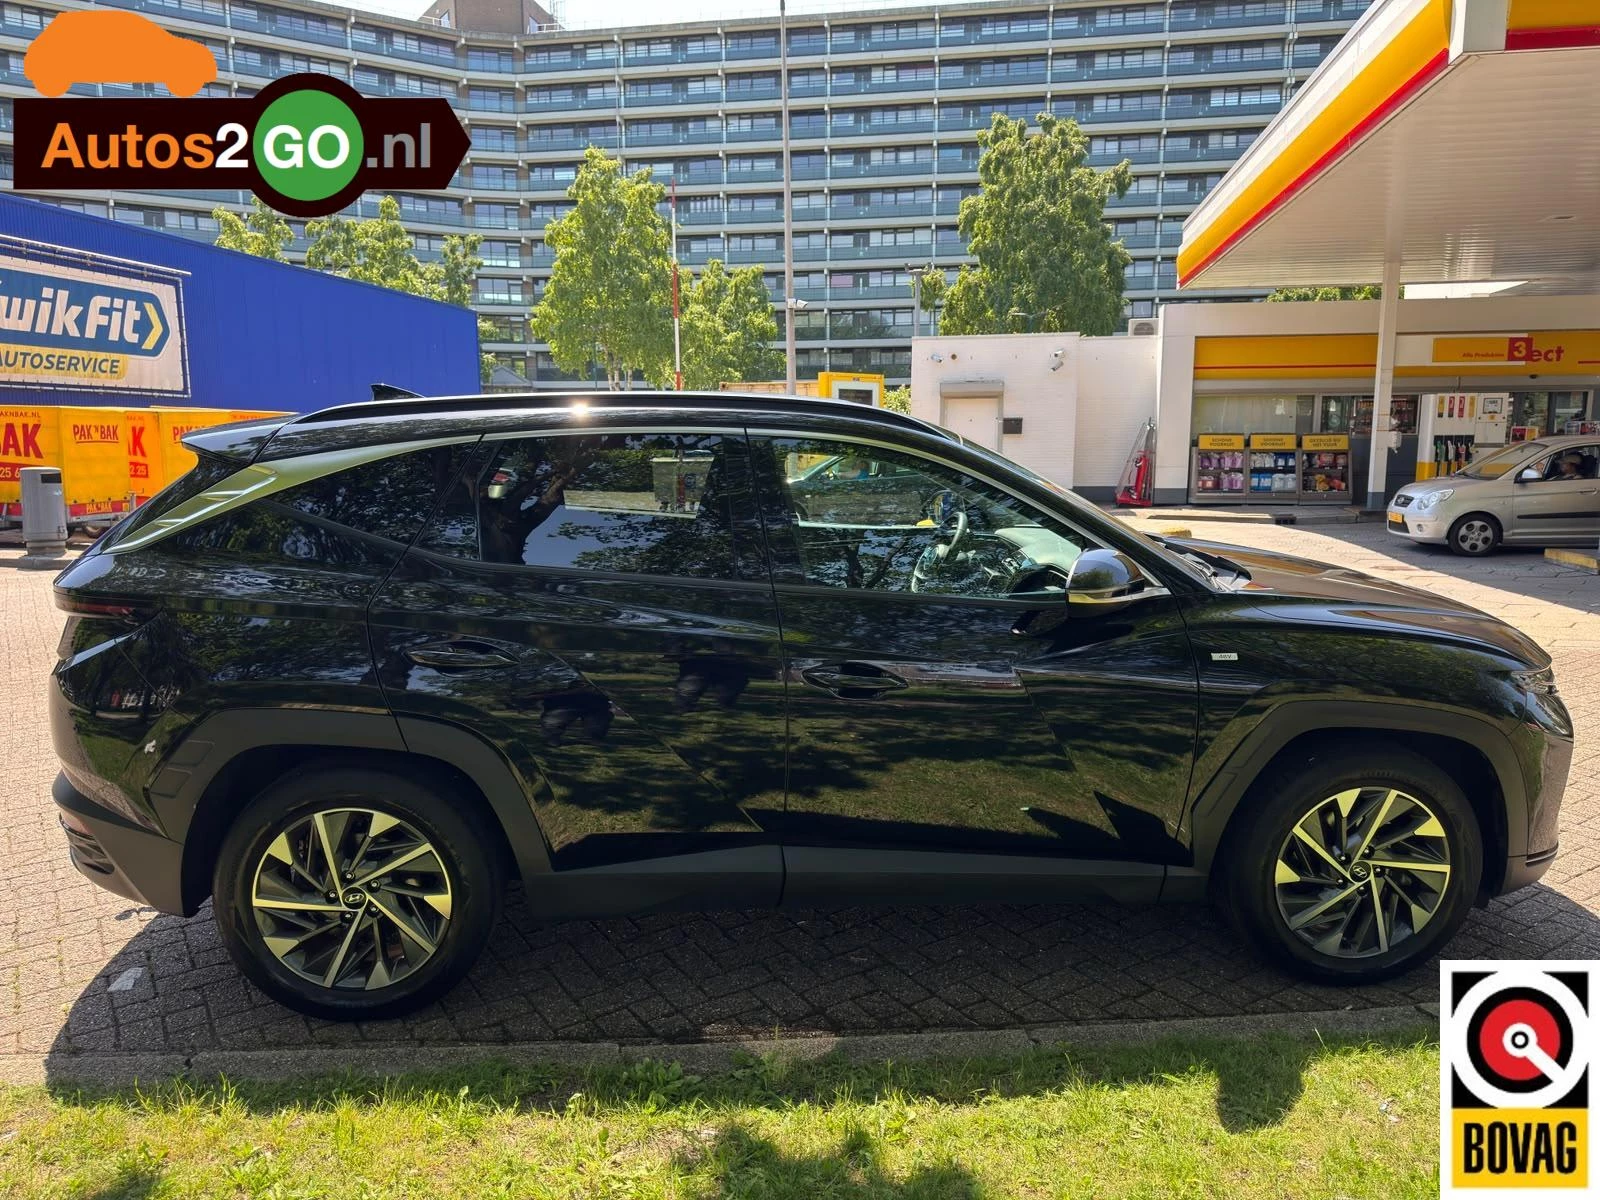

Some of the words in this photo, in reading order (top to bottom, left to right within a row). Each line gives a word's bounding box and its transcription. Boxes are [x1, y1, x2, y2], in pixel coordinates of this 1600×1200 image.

[0, 284, 83, 338] wik
[0, 423, 44, 459] AK
[73, 423, 93, 441] PAK
[100, 424, 119, 441] BAK
[128, 426, 147, 458] K
